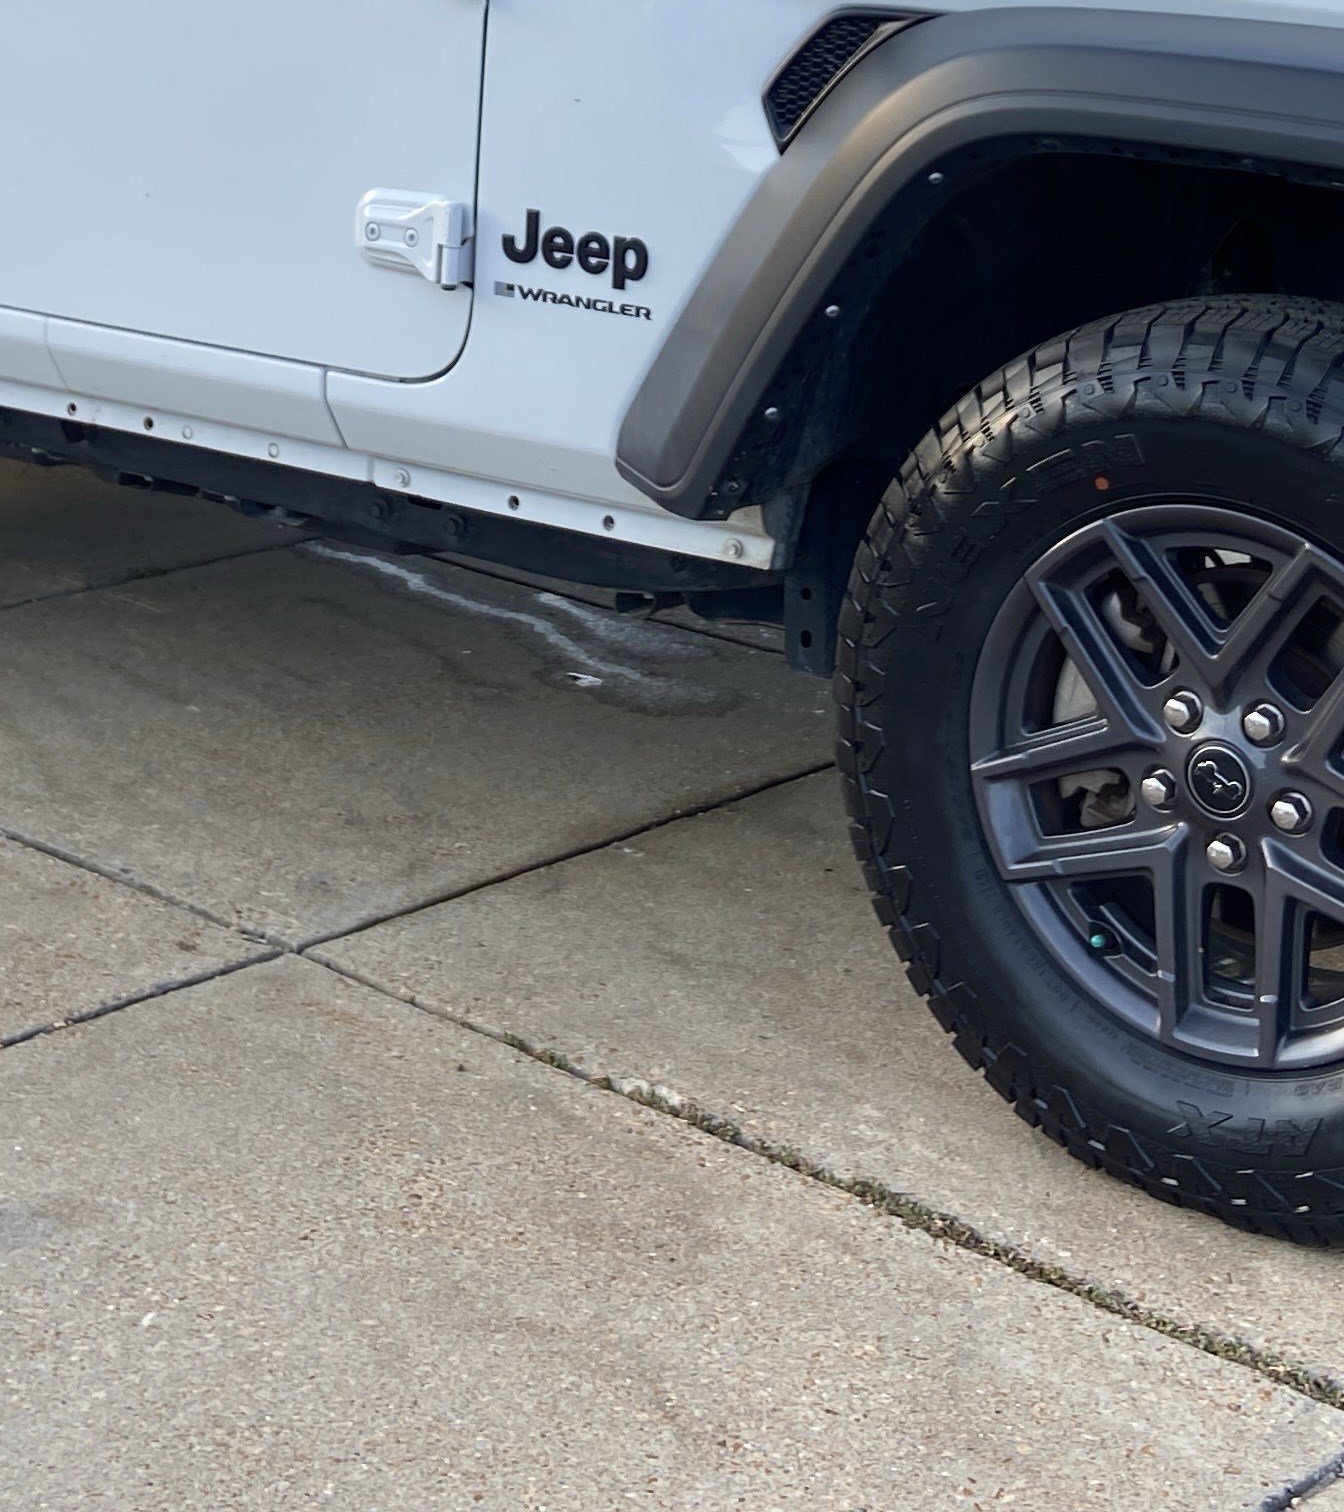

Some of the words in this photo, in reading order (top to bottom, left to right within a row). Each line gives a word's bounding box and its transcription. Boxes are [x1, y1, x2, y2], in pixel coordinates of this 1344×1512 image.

[501, 208, 649, 290] Jeep
[517, 285, 653, 321] WRANGLER
[917, 431, 1147, 644] NEXEN
